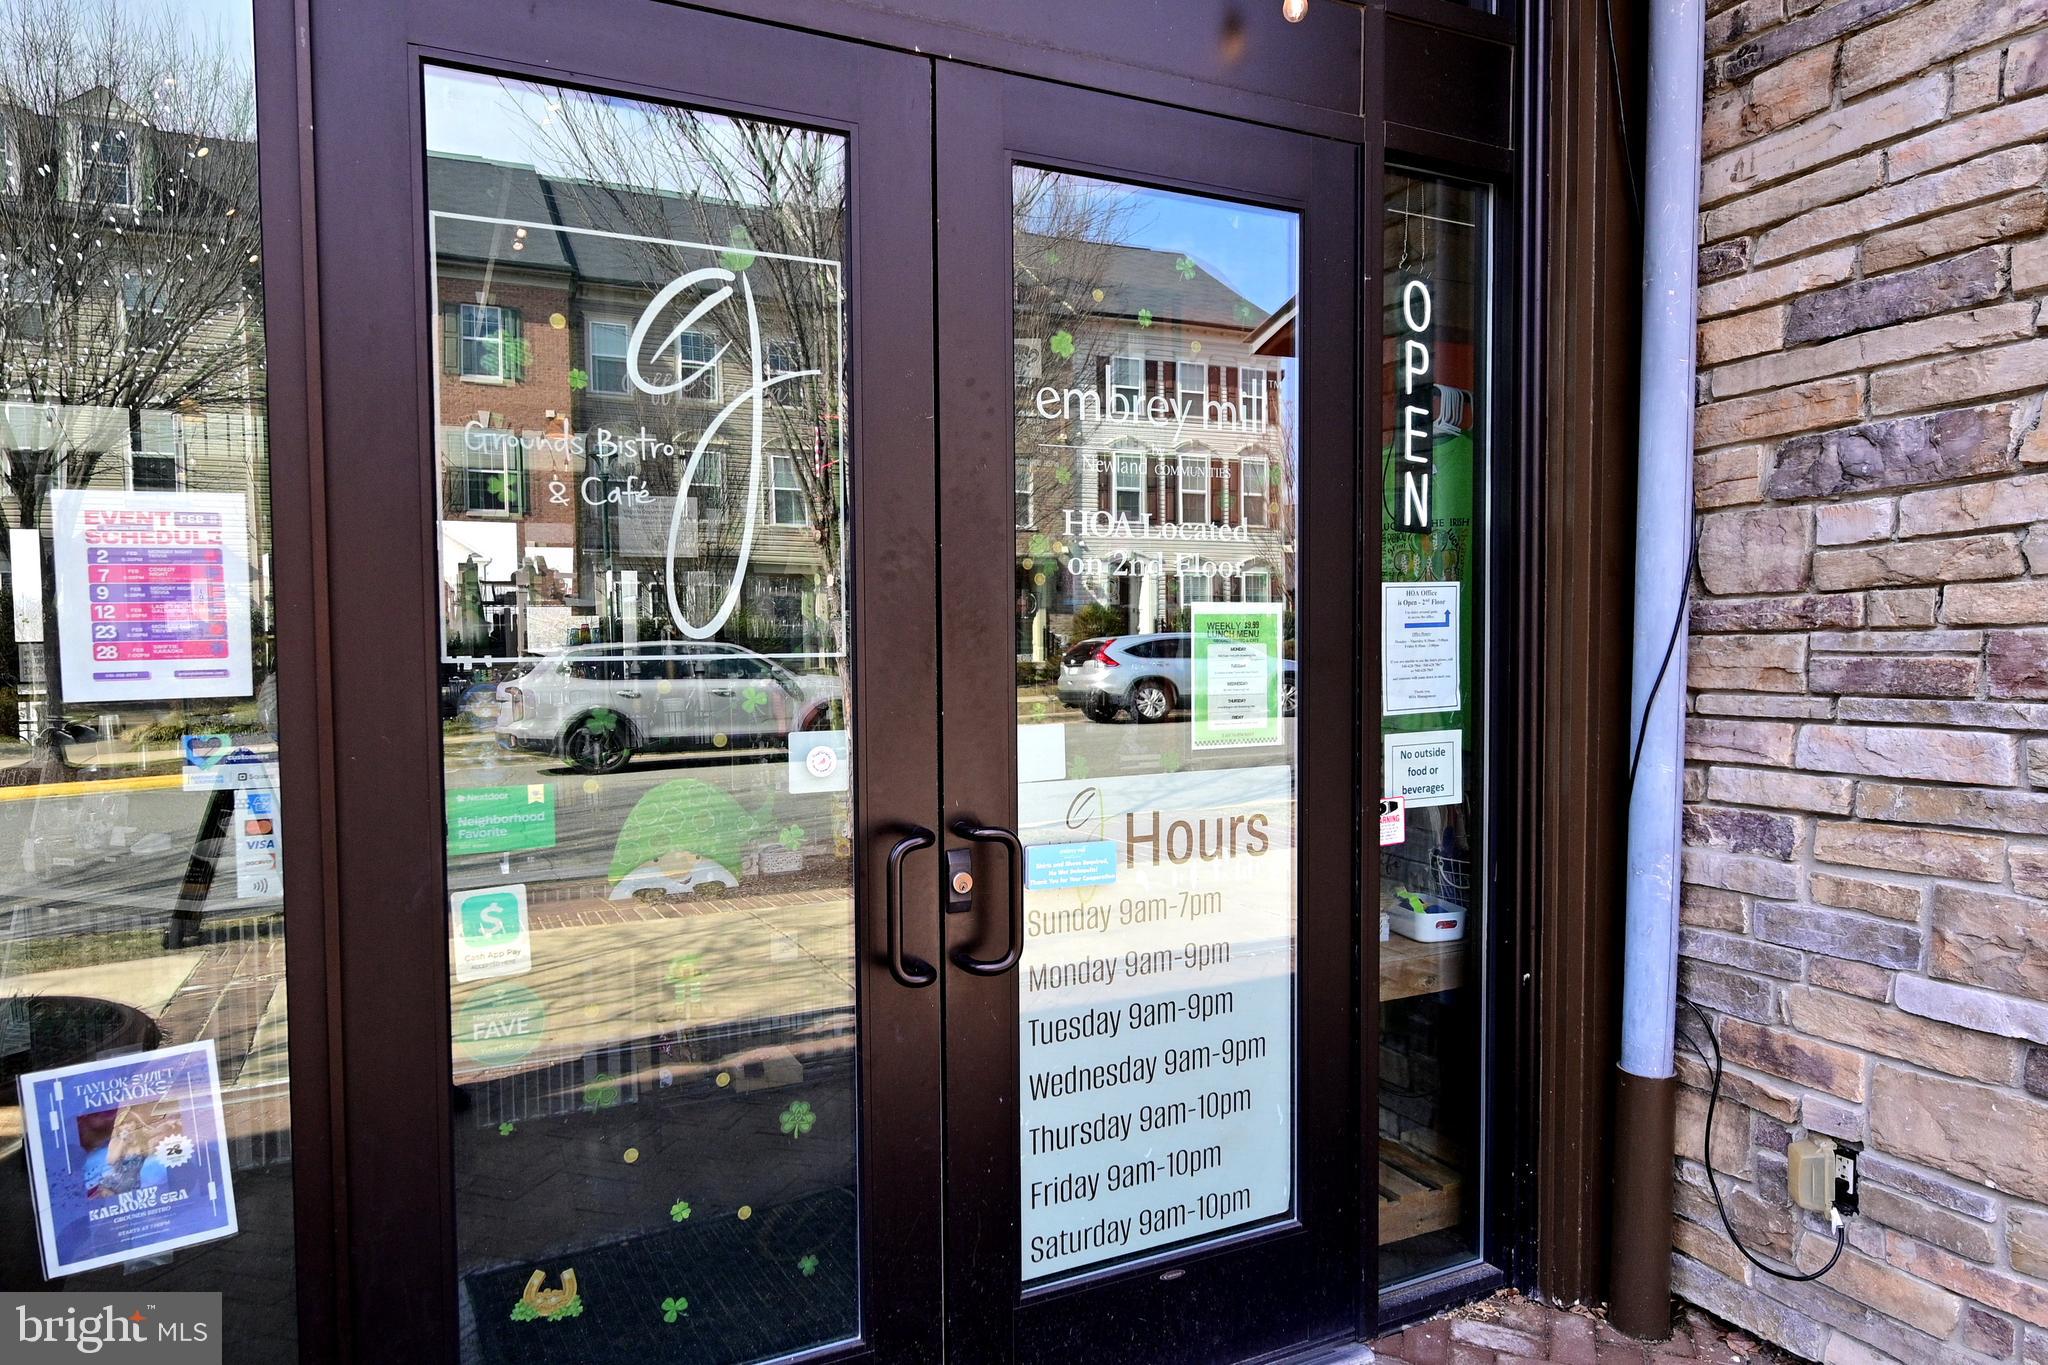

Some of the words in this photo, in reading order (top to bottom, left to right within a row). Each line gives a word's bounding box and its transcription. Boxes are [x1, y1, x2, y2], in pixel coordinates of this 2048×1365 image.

[1036, 365, 1192, 443] embrey
[1203, 378, 1268, 434] mill
[1404, 280, 1431, 528] OPEN
[464, 418, 584, 460] Grounds
[597, 426, 675, 460] Bistro
[1082, 454, 1147, 475] Newland
[1154, 464, 1232, 479] COMMUNITIES
[549, 481, 570, 506] &
[581, 476, 656, 506] Café
[84, 510, 171, 526] EVENT
[1062, 509, 1135, 538] HOA
[1141, 513, 1249, 542] Located
[85, 529, 223, 545] SCHEDULE
[96, 550, 109, 563] 2
[1067, 555, 1104, 577] on
[1112, 549, 1164, 577] 2nd
[1174, 552, 1247, 579] Floor
[98, 569, 110, 582] 7
[97, 587, 109, 600] 9
[95, 605, 116, 619] 12
[95, 625, 117, 639] 23
[1207, 621, 1242, 630] WEEKLY
[1207, 630, 1235, 638] LUNCH
[1237, 630, 1260, 638] MENU
[96, 646, 119, 660] 28
[1400, 749, 1412, 760] No
[1414, 747, 1446, 758] outside
[1408, 766, 1427, 777] food
[1429, 767, 1439, 775] or
[466, 793, 508, 802] Nextdoor
[1402, 783, 1445, 795] beverages
[458, 812, 545, 827] Neighborhood
[459, 827, 508, 839] Favorite
[1126, 811, 1269, 869] Hours
[247, 840, 274, 849] VISA
[1028, 903, 1112, 937] Sunday
[1119, 890, 1222, 925] 9am-7pm
[465, 953, 485, 962] Cash
[487, 951, 504, 960] App
[507, 949, 522, 957] Pay
[1029, 956, 1117, 992] Monday
[1125, 941, 1230, 978] 9am-9pm
[473, 1008, 529, 1022] Neighborhood
[1029, 1008, 1121, 1047] Tuesday
[1129, 991, 1233, 1030] 9am-9pm
[473, 1017, 530, 1041] FAVE
[1029, 1055, 1157, 1101] Wednesday
[1164, 1036, 1266, 1075] 9am-9pm
[74, 1077, 128, 1096] TAYLOR
[131, 1067, 174, 1085] SWIFT
[84, 1081, 171, 1108] KARAOKE
[1029, 1112, 1132, 1155] Thursday
[1139, 1088, 1251, 1132] 9am-10pm
[1031, 1172, 1099, 1210] Friday
[1107, 1145, 1221, 1191] 9am-10pm
[89, 1199, 157, 1221] KARAOKE
[160, 1189, 189, 1204] ERA
[1030, 1217, 1132, 1264] Saturday
[1138, 1188, 1251, 1236] 9am-10pm
